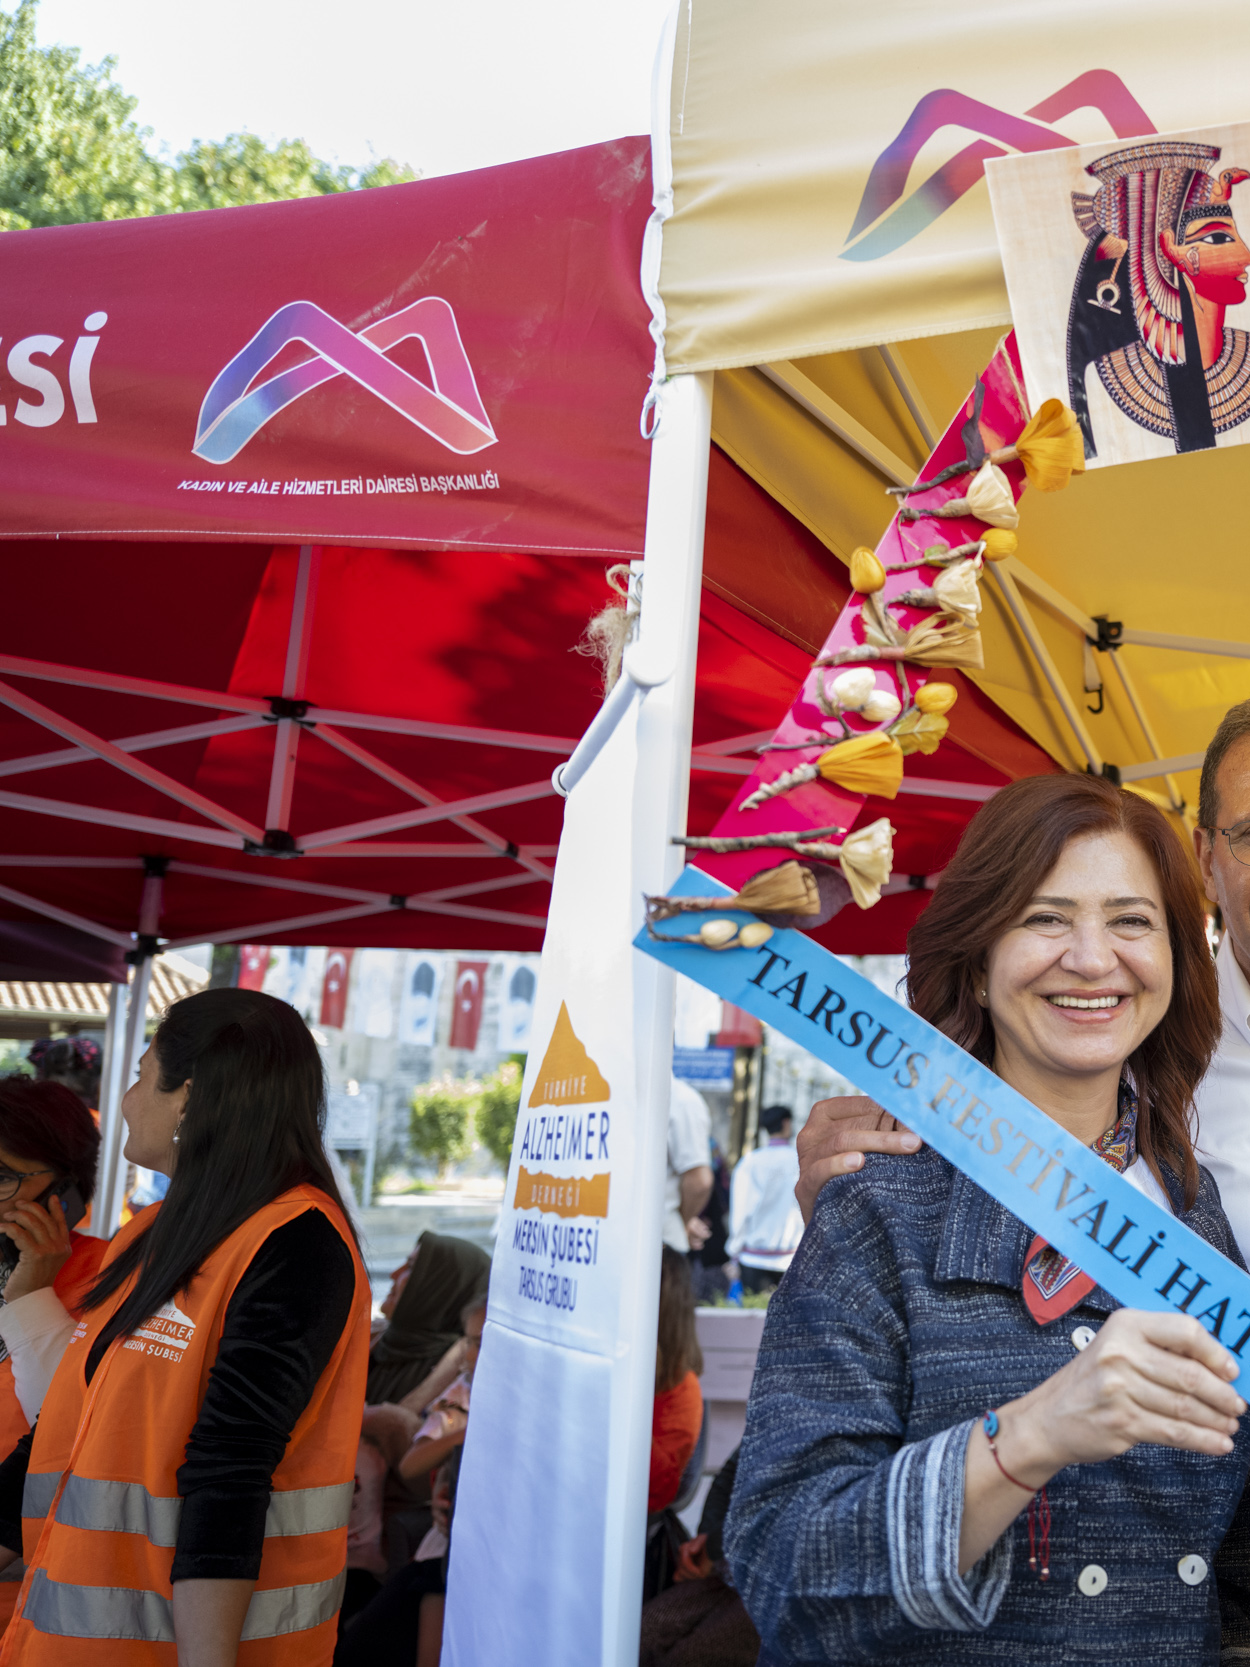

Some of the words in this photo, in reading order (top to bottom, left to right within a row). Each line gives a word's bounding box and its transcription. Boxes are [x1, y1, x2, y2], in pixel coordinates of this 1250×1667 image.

[0, 311, 108, 428] Sİ
[176, 479, 226, 493] KADIN
[227, 480, 248, 494] VE
[247, 478, 281, 495] AİLE
[282, 476, 363, 495] HİZMETLERİ
[366, 473, 419, 494] DAİRESİ
[420, 469, 500, 495] BAŞKANLIĞI
[543, 1073, 588, 1101] TÜRKİYE
[747, 944, 927, 1090] TARSUS
[925, 1071, 1168, 1280] FESTİVALİ
[519, 1111, 610, 1160] ALZHEIMER
[531, 1180, 581, 1208] DERNEĞİ
[512, 1213, 551, 1257] MERSİN
[550, 1218, 600, 1269] ŞUBESİ
[518, 1265, 545, 1304] TARSUS
[147, 1344, 184, 1363] ŞUBESİ
